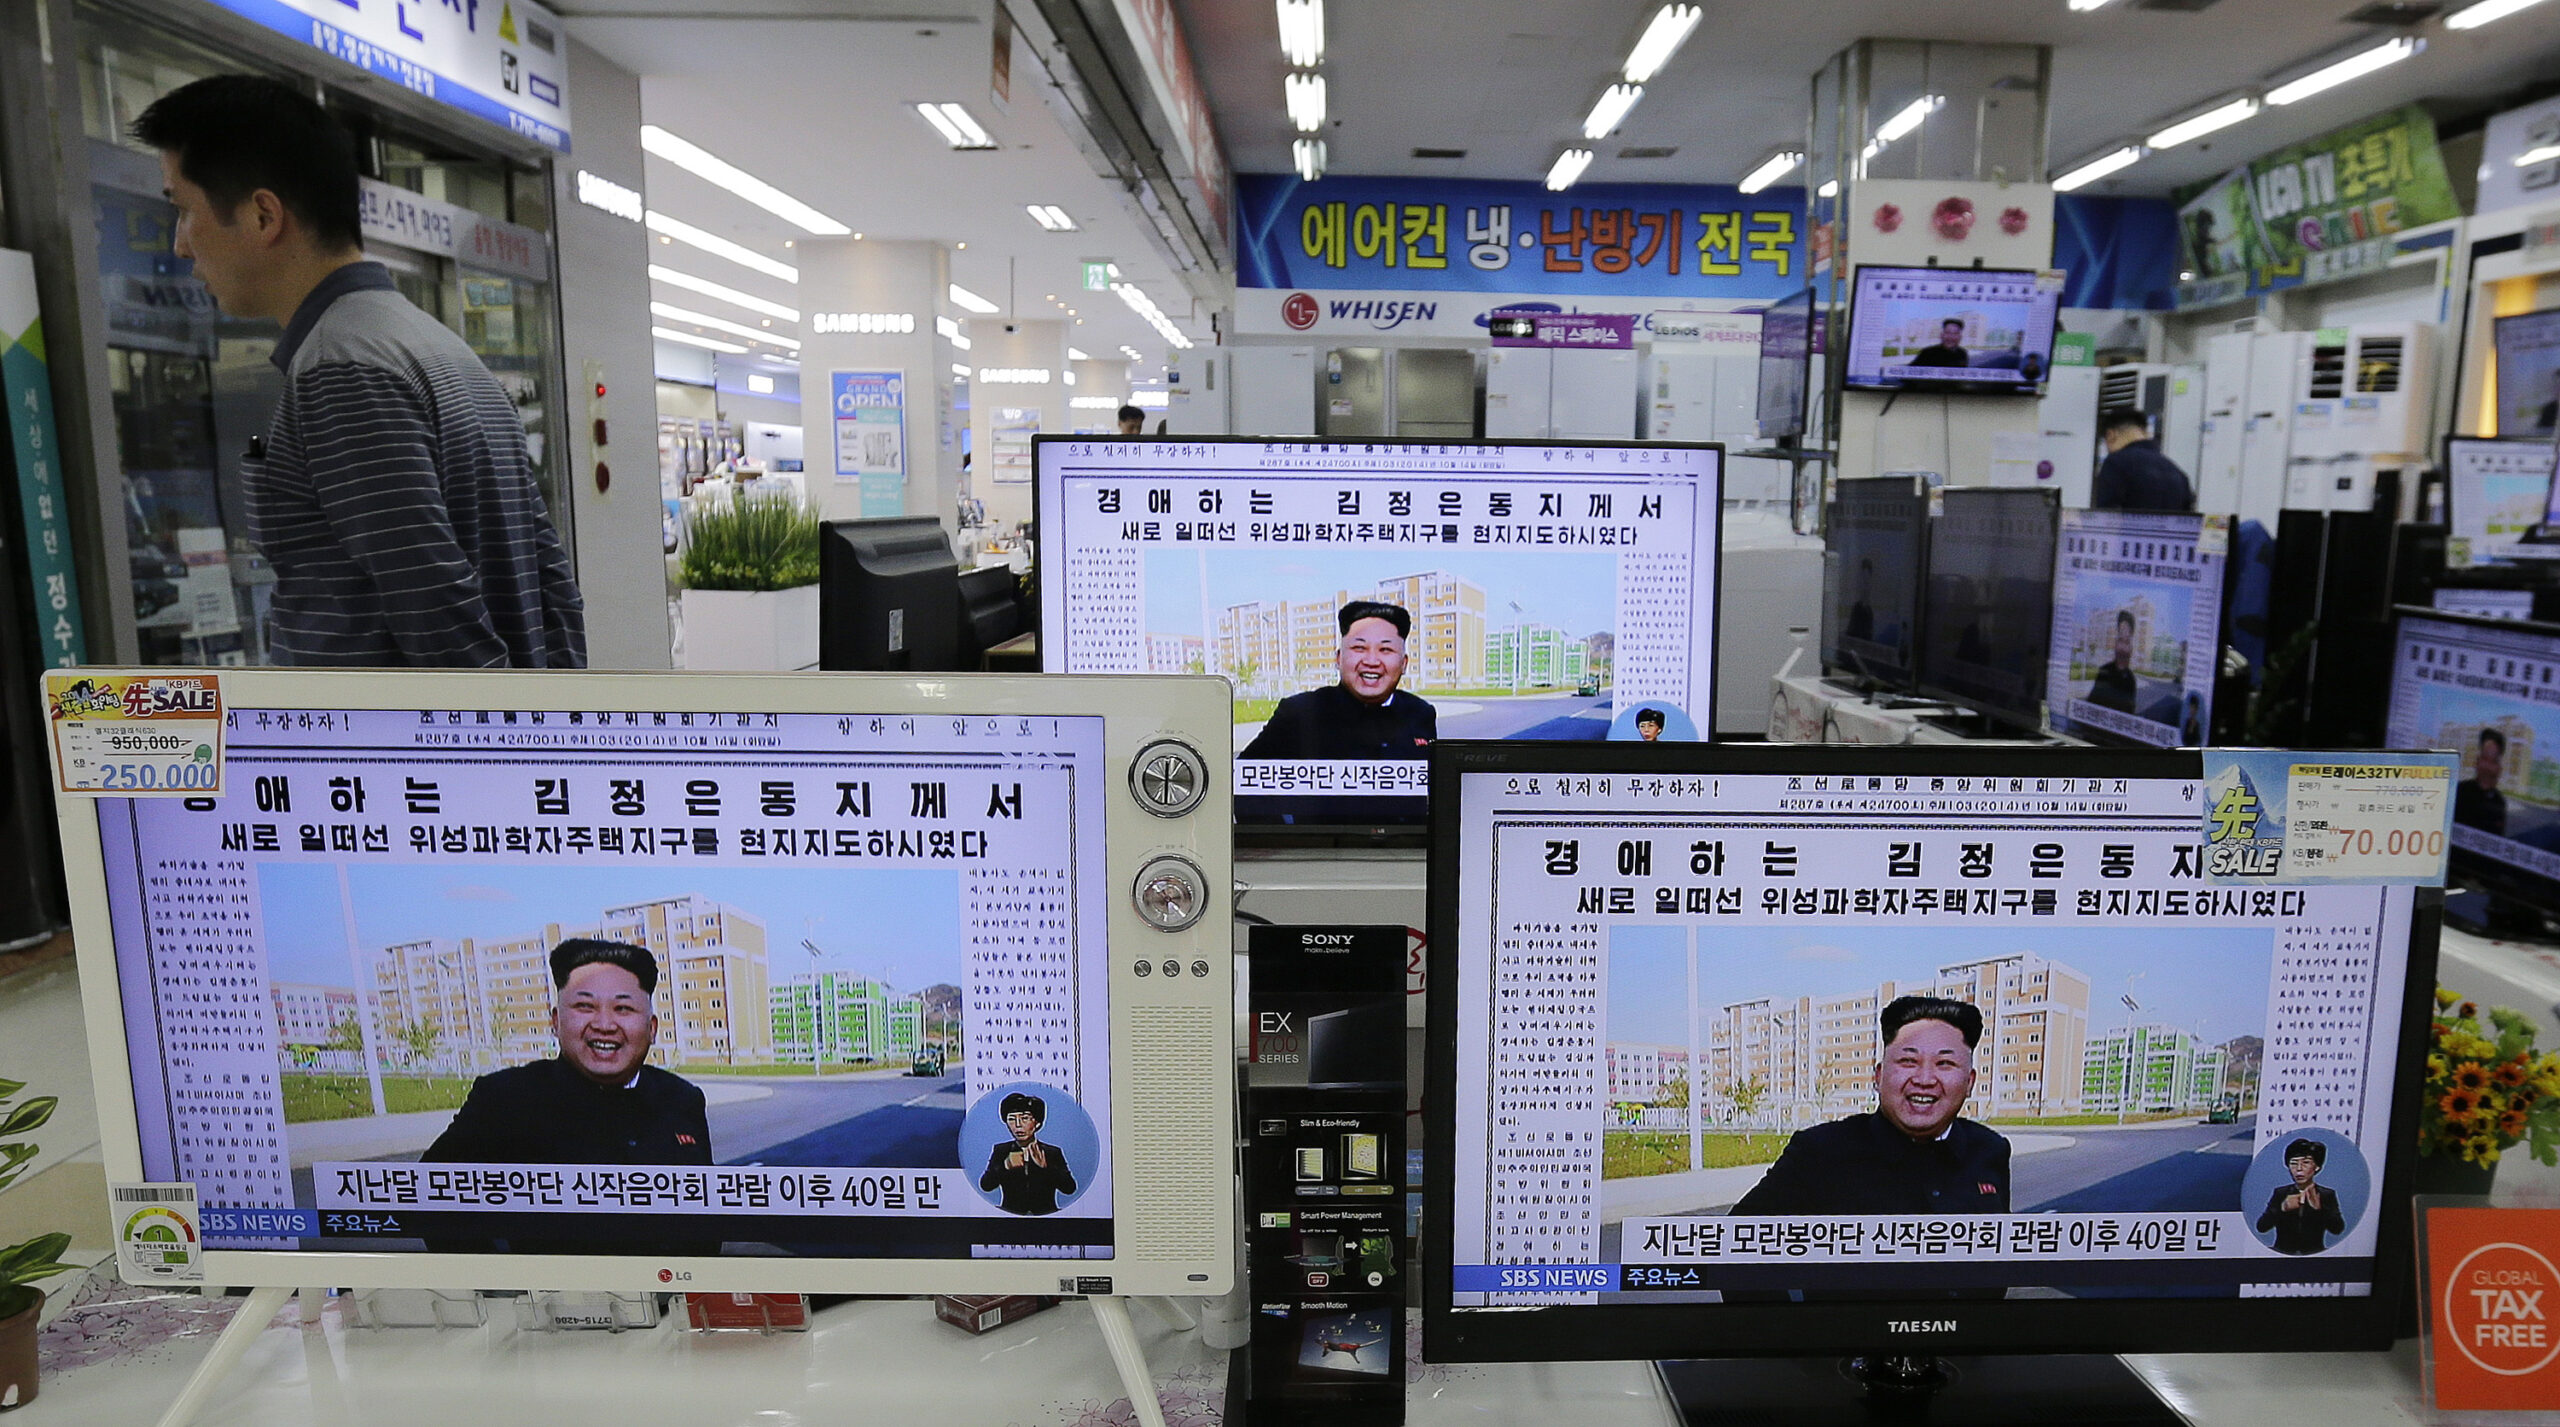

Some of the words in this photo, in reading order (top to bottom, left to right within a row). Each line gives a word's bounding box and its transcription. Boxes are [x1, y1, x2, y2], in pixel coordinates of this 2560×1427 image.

[1301, 201, 1449, 269] 에어컨
[1697, 211, 1797, 276] 전국
[813, 313, 915, 333] SAMSUNG
[1330, 300, 1437, 325] WHISEN
[1097, 488, 1274, 515] 경애하는
[1337, 490, 1662, 519] 김정은동지께서
[1121, 521, 1162, 541] 새로
[1175, 521, 1236, 541] 일떠선
[1250, 523, 1459, 544] 위성과학자주택지구를
[1474, 525, 1638, 546] 현지지도하시였다
[123, 683, 153, 717] 先
[152, 690, 217, 712] SALE
[111, 736, 179, 751] 950,000
[1240, 765, 1335, 790] 모란봉악단
[1504, 778, 1541, 796] 으로
[1555, 778, 1612, 798] 철저히
[1627, 778, 1720, 798] 무장하자!
[534, 778, 1023, 820] 김정은동지께서
[2210, 786, 2259, 843] 先
[221, 823, 281, 852] 새로
[298, 824, 390, 853] 일떠선
[409, 825, 719, 856] 위성과학자주택지구를
[740, 829, 989, 859] 현지지도하시였다
[1544, 840, 1798, 877] 경애하는
[2209, 848, 2283, 877] SALE
[1576, 887, 1636, 915] 새로
[1654, 887, 1742, 915] 일떠선
[1760, 888, 2058, 916] 위성과학자주택지구를
[2075, 889, 2306, 917] 현지지도하시였다
[1302, 934, 1355, 945] SONY
[1260, 1012, 1292, 1033] EX
[1261, 1035, 1299, 1053] 700
[1259, 1054, 1300, 1064] SERIES
[1300, 1119, 1315, 1127] Slim
[1322, 1119, 1360, 1129] Eco-friendly
[337, 1169, 420, 1205] 지난달
[428, 1170, 564, 1207] 모란봉악단
[571, 1171, 709, 1208] 신작음악회
[716, 1173, 772, 1208] 관람
[779, 1173, 835, 1209] 이후
[841, 1174, 906, 1210] 40일
[914, 1175, 942, 1210] 만
[199, 1213, 238, 1231] SBS
[243, 1214, 307, 1232] NEWS
[325, 1214, 401, 1232] 주요뉴스
[1300, 1212, 1320, 1220] Smart
[1320, 1212, 1341, 1220] Power
[1341, 1212, 1382, 1221] Management
[1643, 1222, 1726, 1257] 지난달
[1732, 1221, 1865, 1257] 모란봉악단
[1871, 1219, 2003, 1256] 신작음악회
[2009, 1219, 2063, 1254] 관람
[2069, 1218, 2121, 1254] 이후
[2126, 1218, 2188, 1253] 40일
[2194, 1218, 2221, 1252] 만
[676, 1271, 692, 1281] LG
[1500, 1269, 1541, 1287] SBS
[1545, 1269, 1608, 1287] NEWS
[1626, 1268, 1701, 1287] 주요뉴스
[2473, 1270, 2544, 1286] GLOBAL
[2470, 1289, 2546, 1321] TAX
[1887, 1320, 1957, 1333] TAESAN
[2475, 1324, 2548, 1348] FREE
